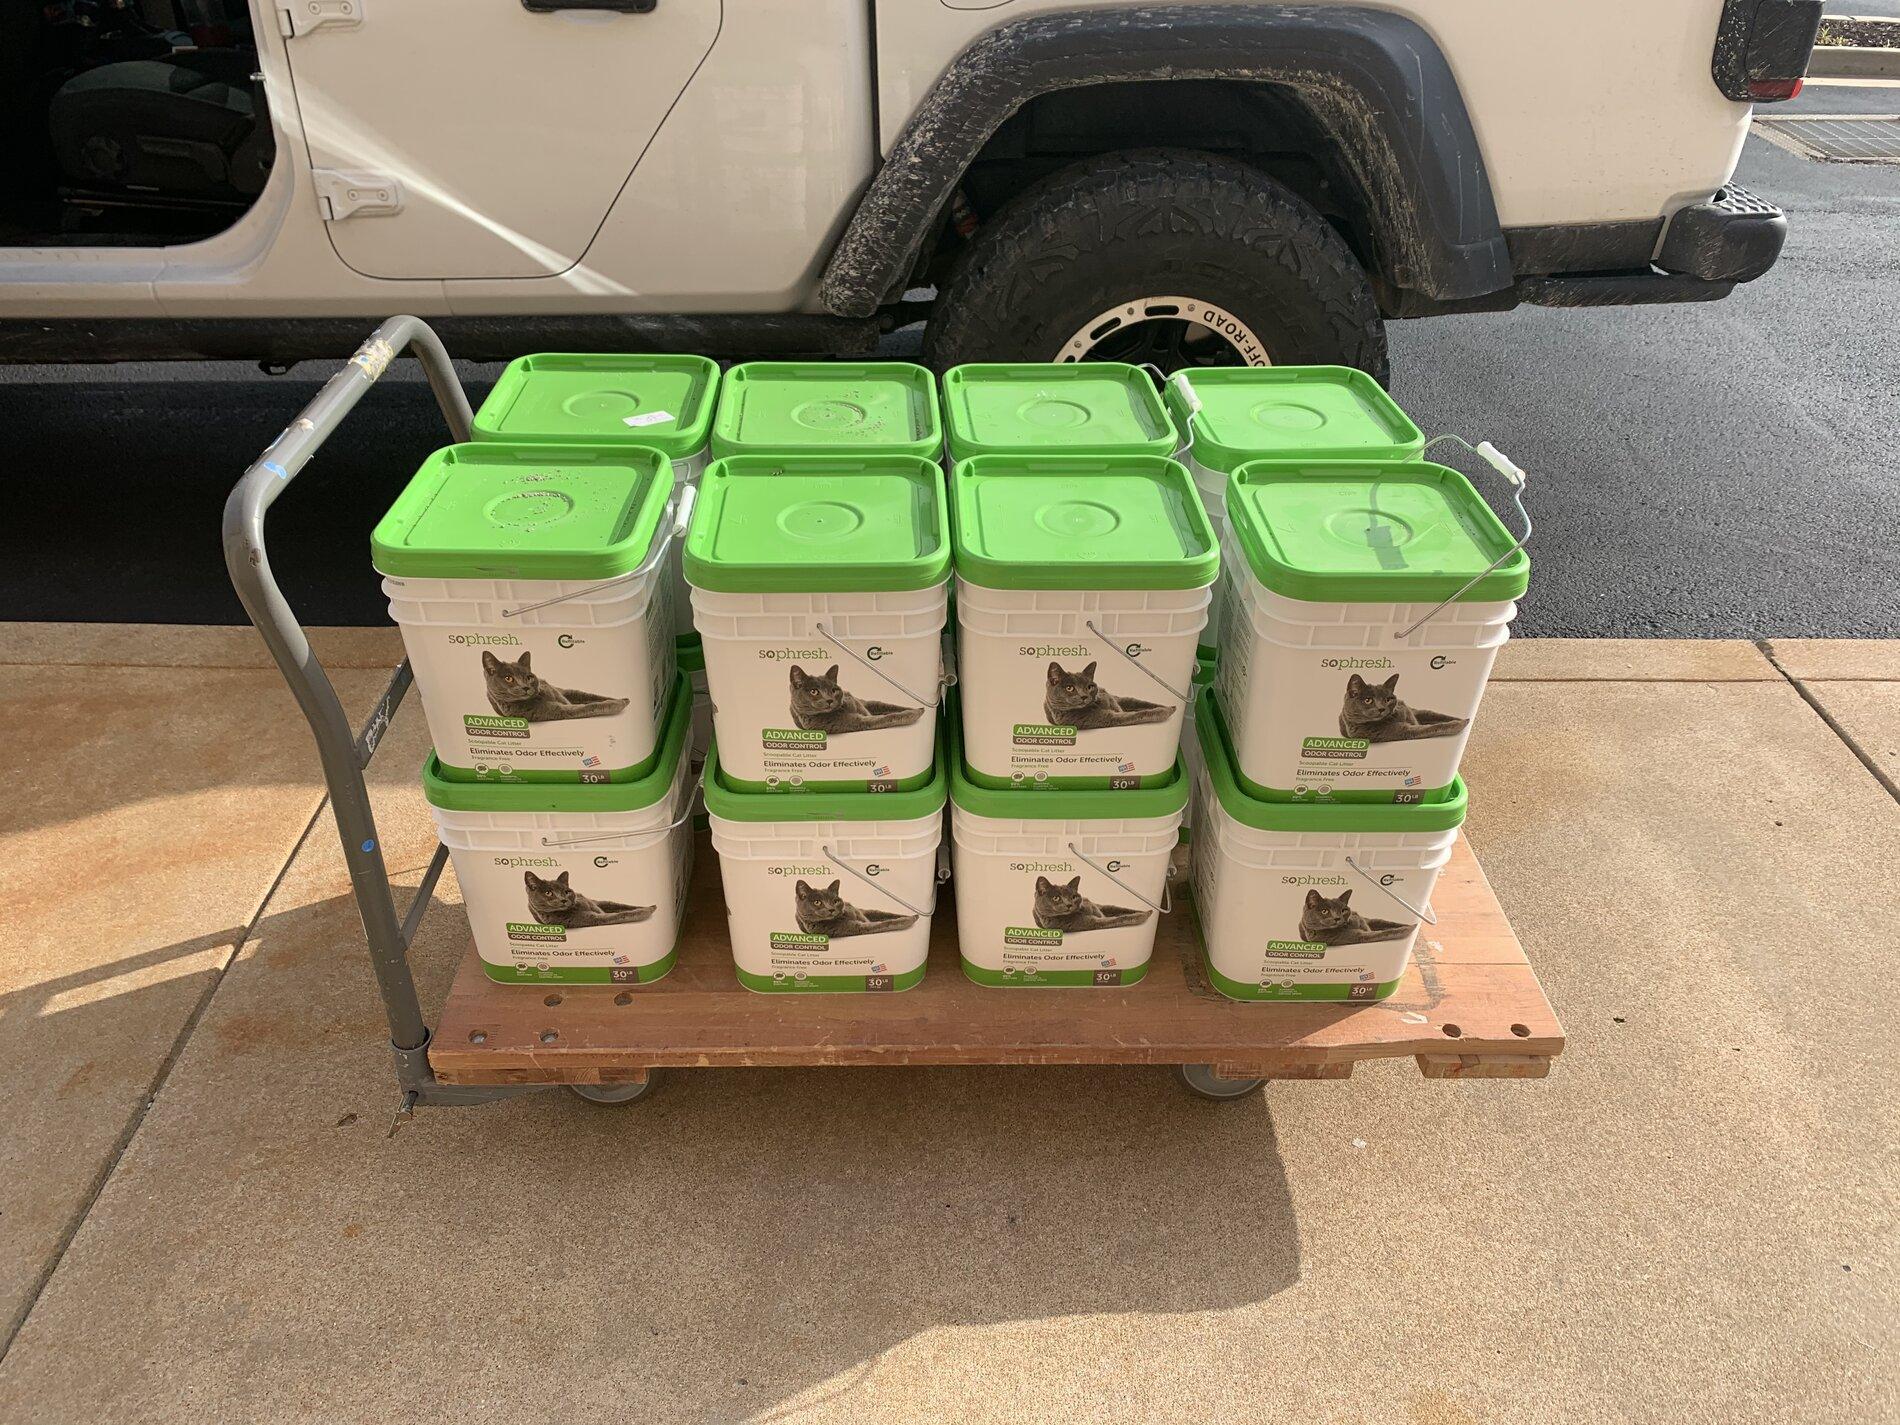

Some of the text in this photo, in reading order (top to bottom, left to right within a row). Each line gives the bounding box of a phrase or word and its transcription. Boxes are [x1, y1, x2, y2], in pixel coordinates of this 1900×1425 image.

[467, 717, 525, 728] ADVANCED
[766, 731, 823, 740] ADVANCED
[1017, 726, 1073, 736] ADVANCED
[1306, 740, 1366, 749] ADVANCED
[469, 747, 513, 756] Eliminates
[1008, 929, 1060, 937] ADVANCED
[773, 934, 826, 943] ADVANCED
[1270, 943, 1323, 951] ADVANCED
